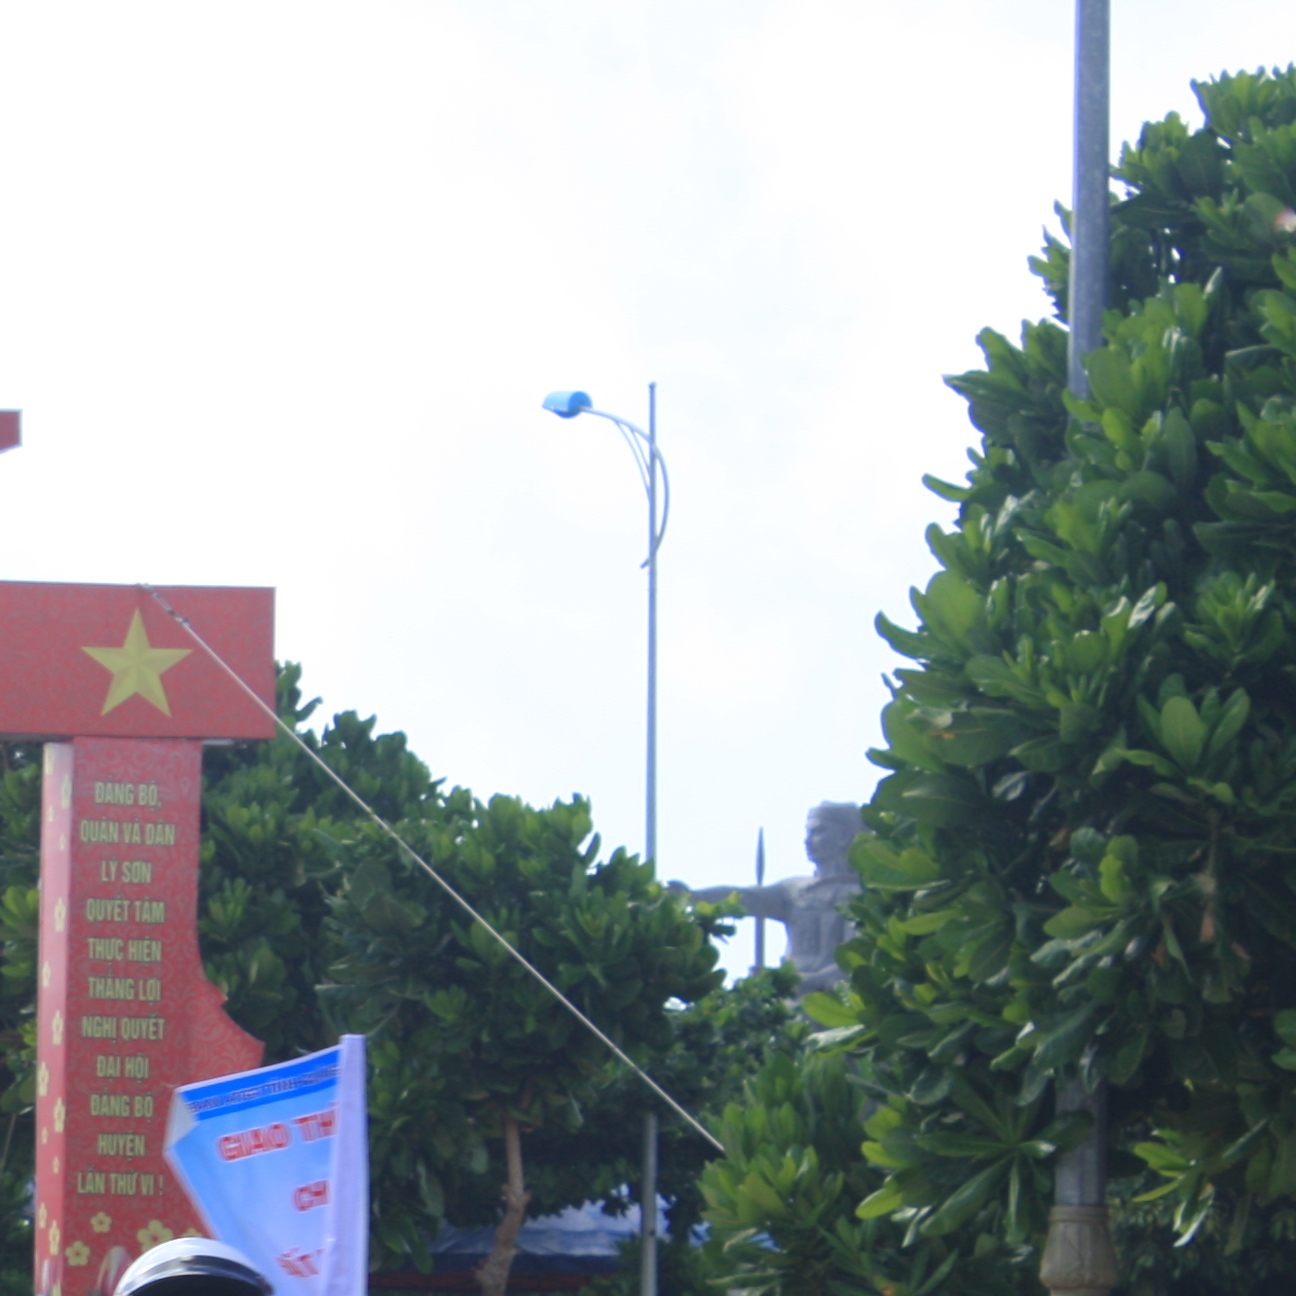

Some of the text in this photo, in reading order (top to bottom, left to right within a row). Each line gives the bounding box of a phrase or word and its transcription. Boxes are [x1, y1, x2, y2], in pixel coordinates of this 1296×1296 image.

[94, 776, 134, 806] ĐẢNG
[79, 816, 176, 846] QUÂN VÀ DÂN
[101, 856, 152, 884] LÝ SƠN
[84, 893, 166, 924] QUYẾT TÂM
[87, 936, 162, 966] THỰC HIỆN
[87, 971, 161, 1005] THẮNG LỢI
[81, 1013, 165, 1043] NGHỊ QUYẾT
[96, 1052, 149, 1083] ĐẠI HỘI
[90, 1088, 154, 1122] ĐẢNG BỘ
[98, 1131, 145, 1161] HUYỆN
[216, 1122, 291, 1161] GIAO
[77, 1167, 105, 1195] LẦN
[109, 1168, 139, 1195] THỨ
[141, 1173, 154, 1196] VI
